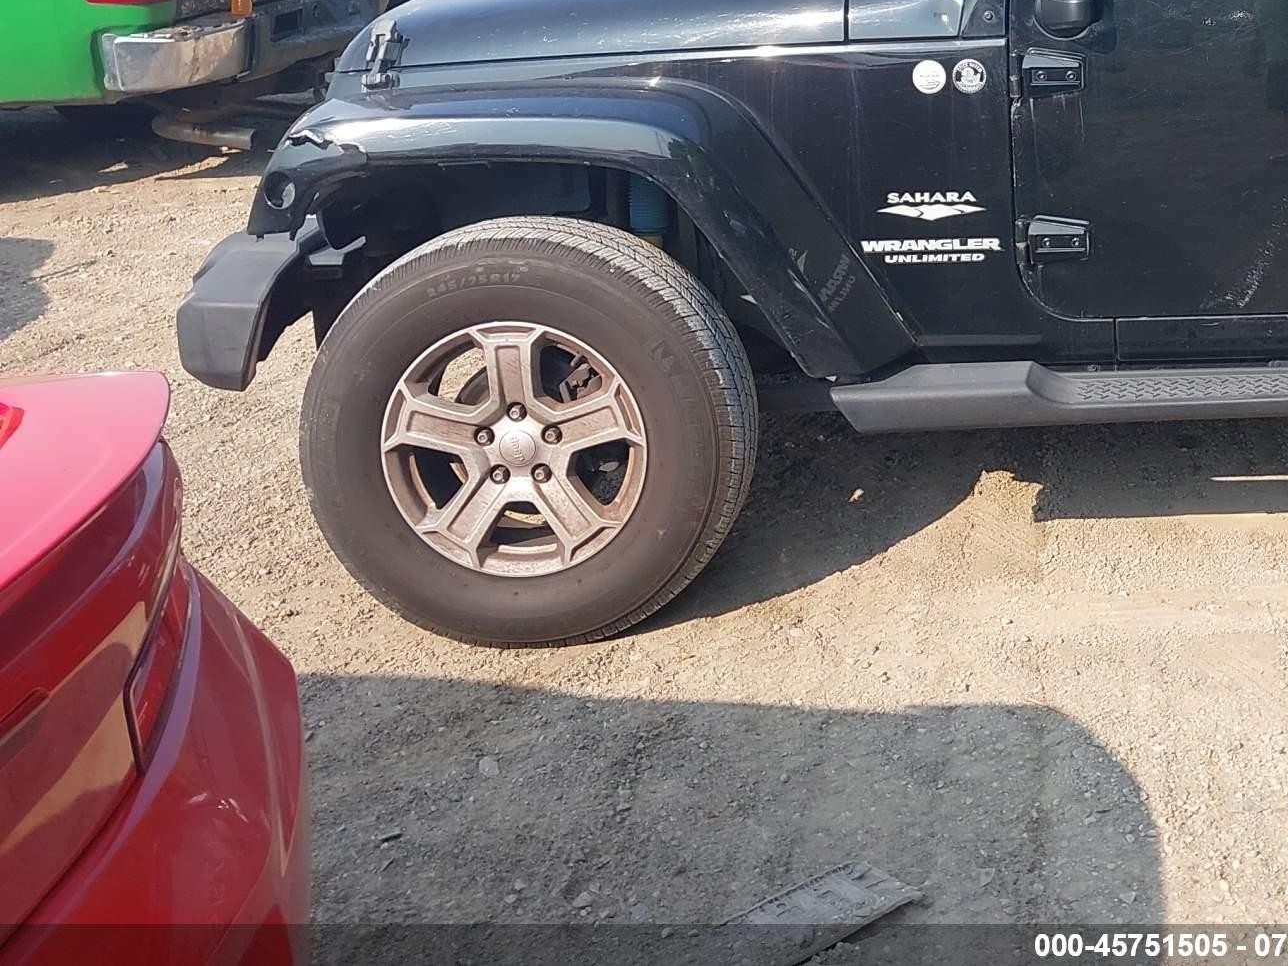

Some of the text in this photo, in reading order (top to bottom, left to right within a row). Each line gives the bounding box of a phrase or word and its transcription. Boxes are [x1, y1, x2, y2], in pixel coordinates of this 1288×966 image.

[886, 191, 977, 204] SAHARA
[860, 237, 1002, 252] WRANGLER
[884, 253, 986, 264] UNLIMITED
